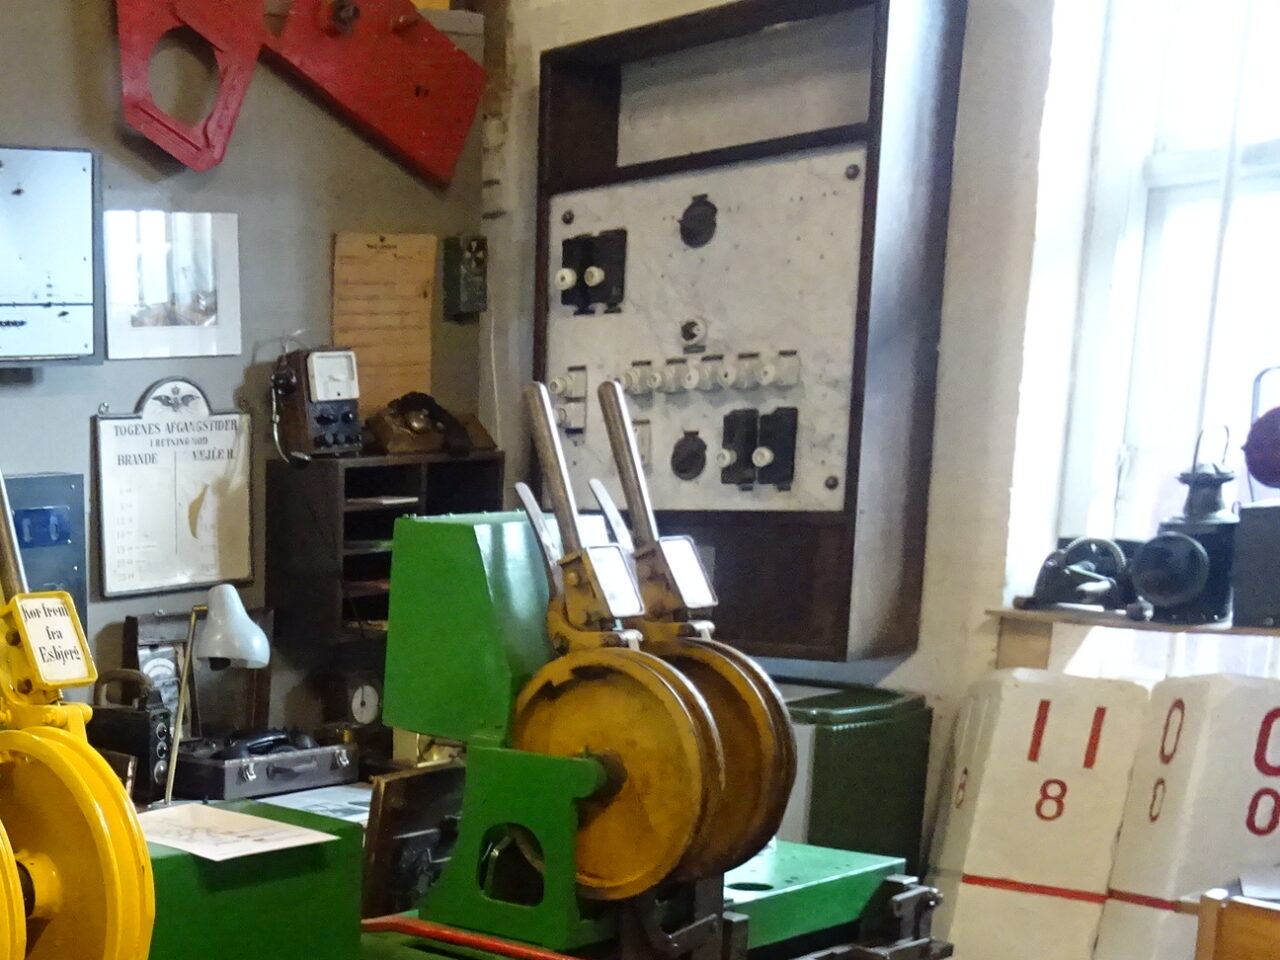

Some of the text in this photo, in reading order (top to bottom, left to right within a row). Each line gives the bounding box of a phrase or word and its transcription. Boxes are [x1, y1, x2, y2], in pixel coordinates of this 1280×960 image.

[117, 453, 158, 466] BRANDE
[46, 626, 63, 640] fra
[39, 646, 81, 666] Esbjerg
[1035, 778, 1067, 821] 8
